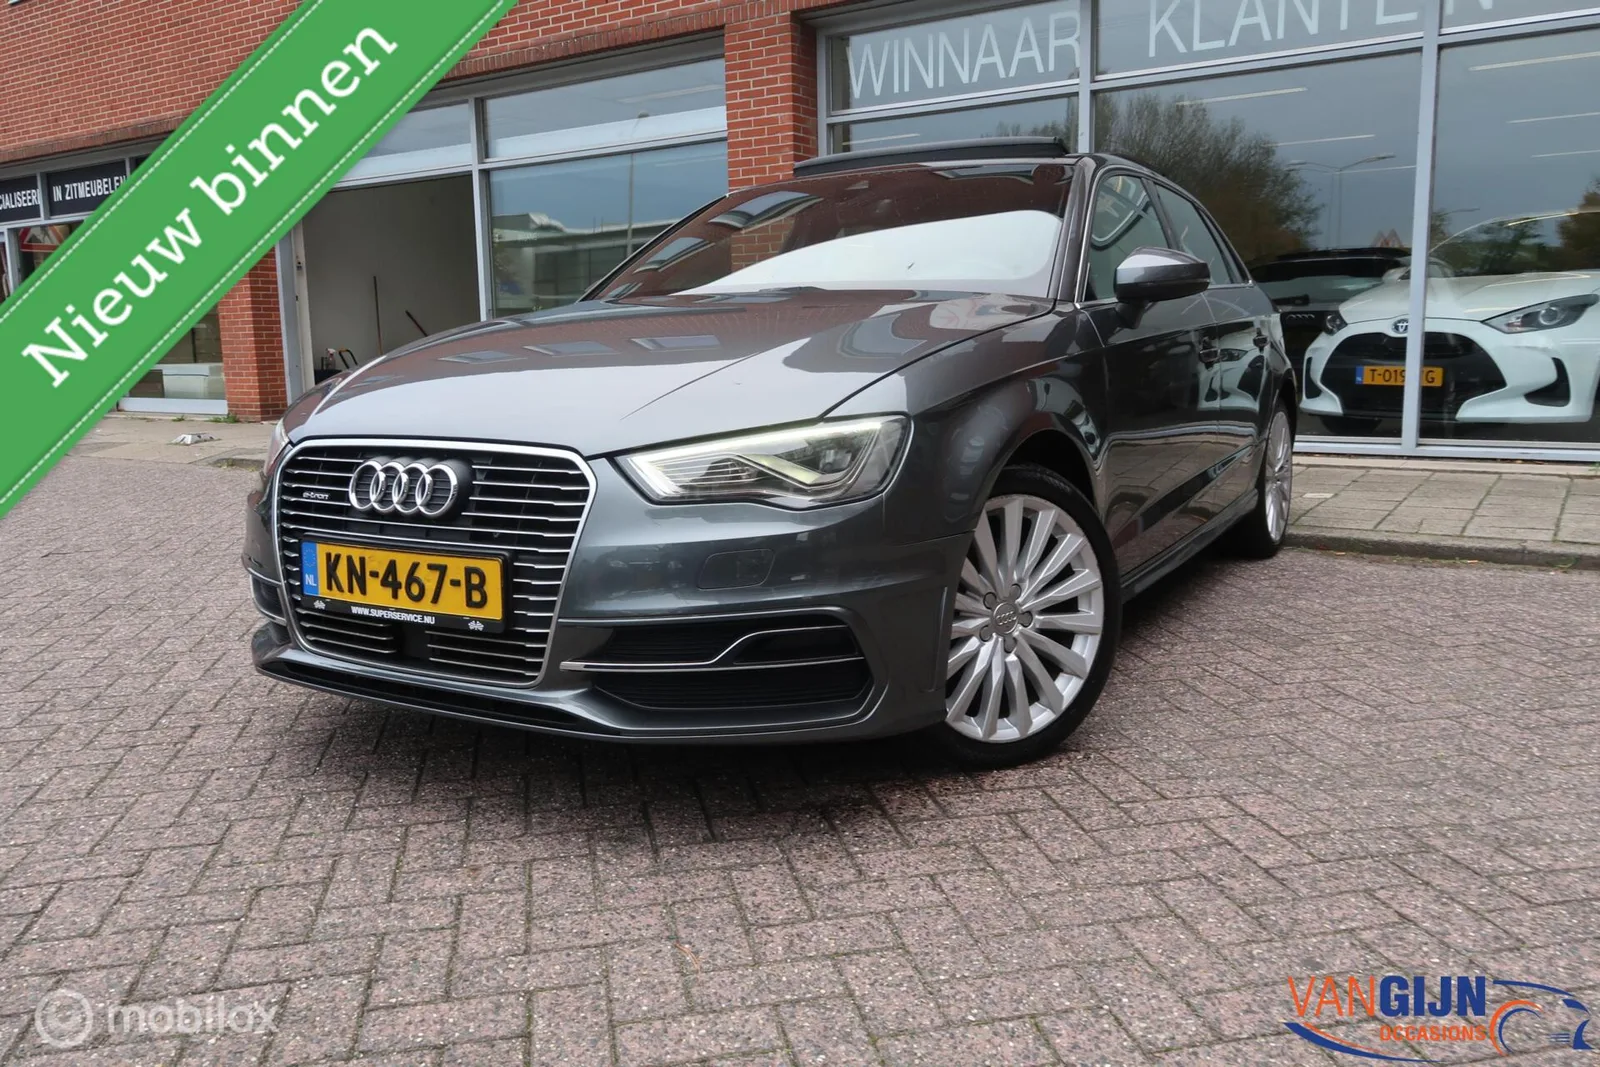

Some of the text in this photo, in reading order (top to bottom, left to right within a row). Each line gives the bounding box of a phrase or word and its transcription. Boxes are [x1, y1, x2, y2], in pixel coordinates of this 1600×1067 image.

[846, 0, 1494, 99] WINNAAR KLAN
[53, 185, 62, 202] IN
[1369, 368, 1435, 384] T-019G
[305, 552, 488, 609] NL KN-467-B
[351, 606, 435, 624] WWW.SUPERSERVICE.NU
